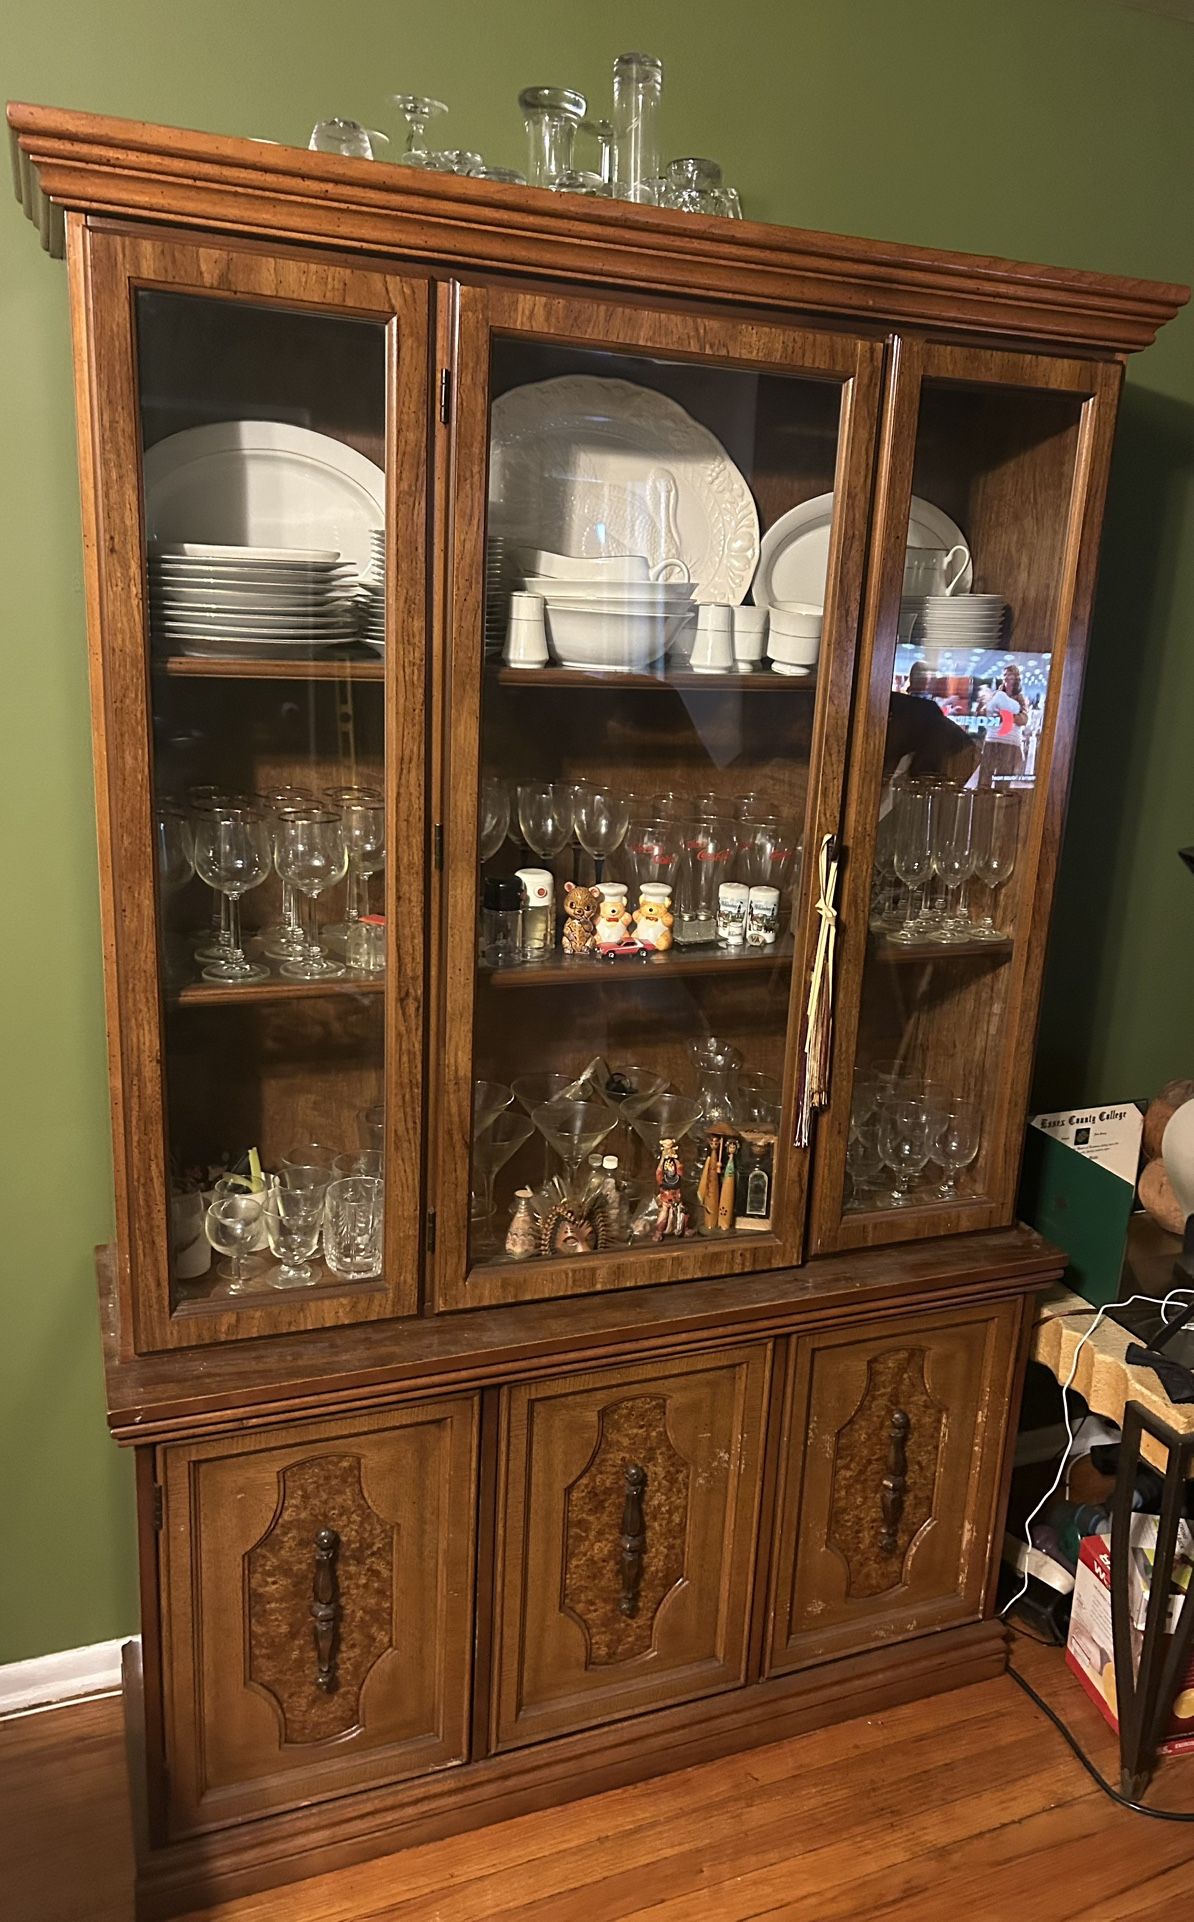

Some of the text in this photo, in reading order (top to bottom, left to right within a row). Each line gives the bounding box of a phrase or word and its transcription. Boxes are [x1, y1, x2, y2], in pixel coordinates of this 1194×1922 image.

[1041, 1110, 1127, 1128] Essex County College
